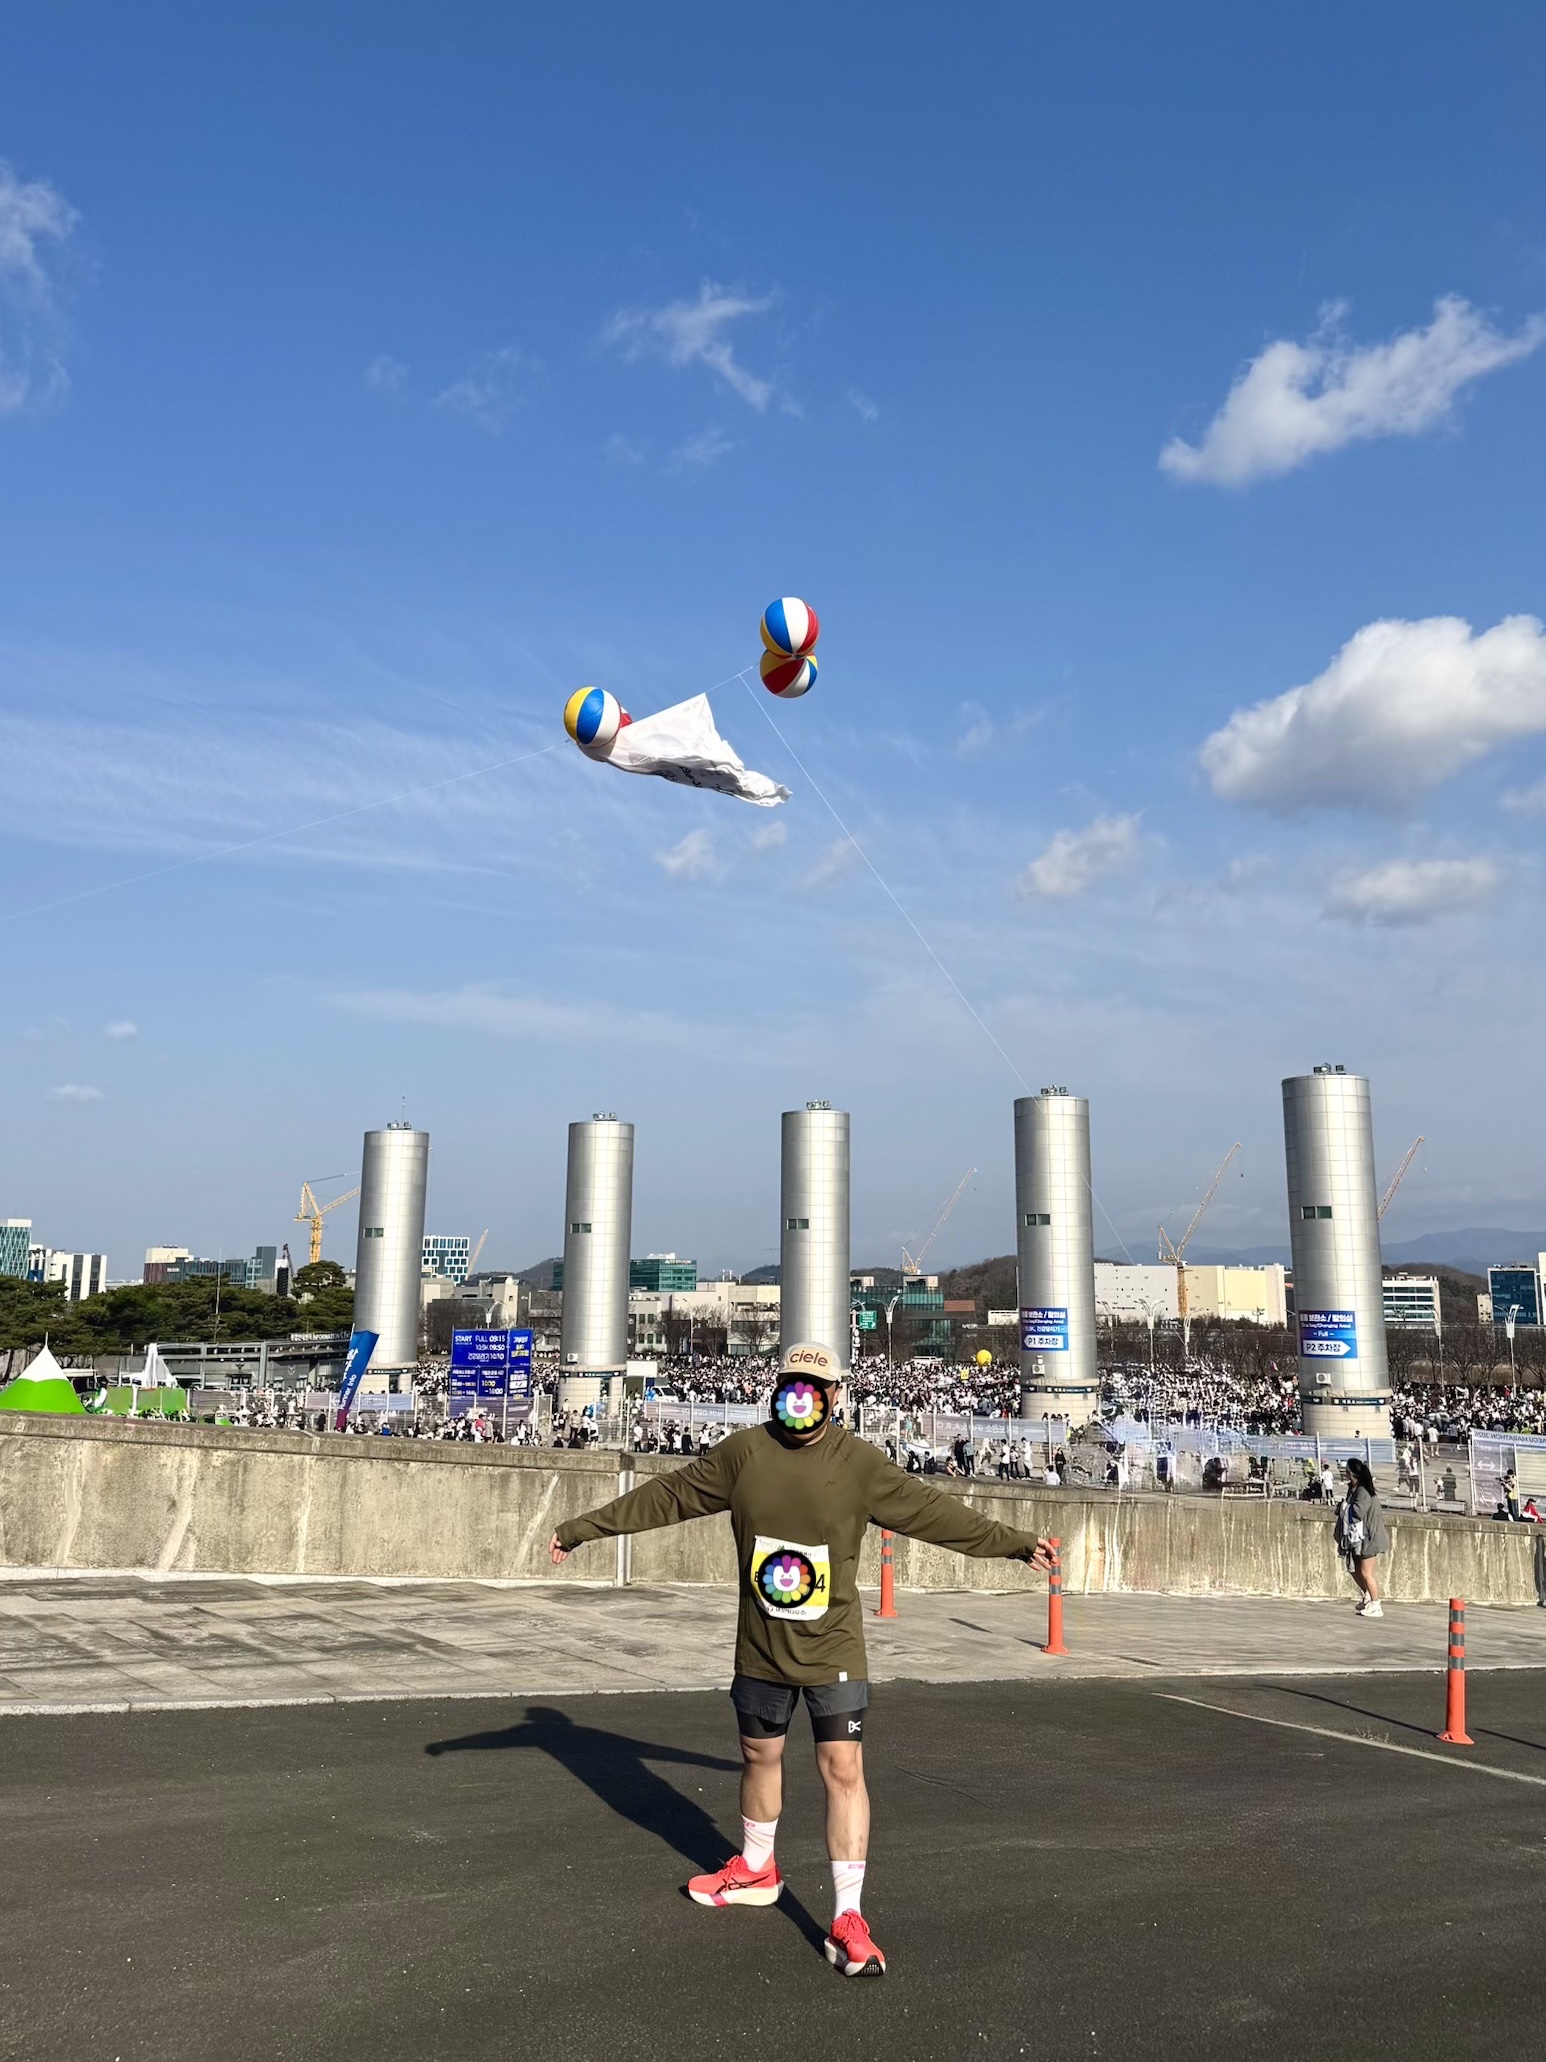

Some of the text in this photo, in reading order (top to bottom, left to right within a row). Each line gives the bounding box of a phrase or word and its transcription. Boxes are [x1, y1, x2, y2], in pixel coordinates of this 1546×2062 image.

[1028, 1337, 1058, 1346] P1 주차장
[1306, 1343, 1341, 1352] P2 주차장
[789, 1350, 828, 1367] ciele
